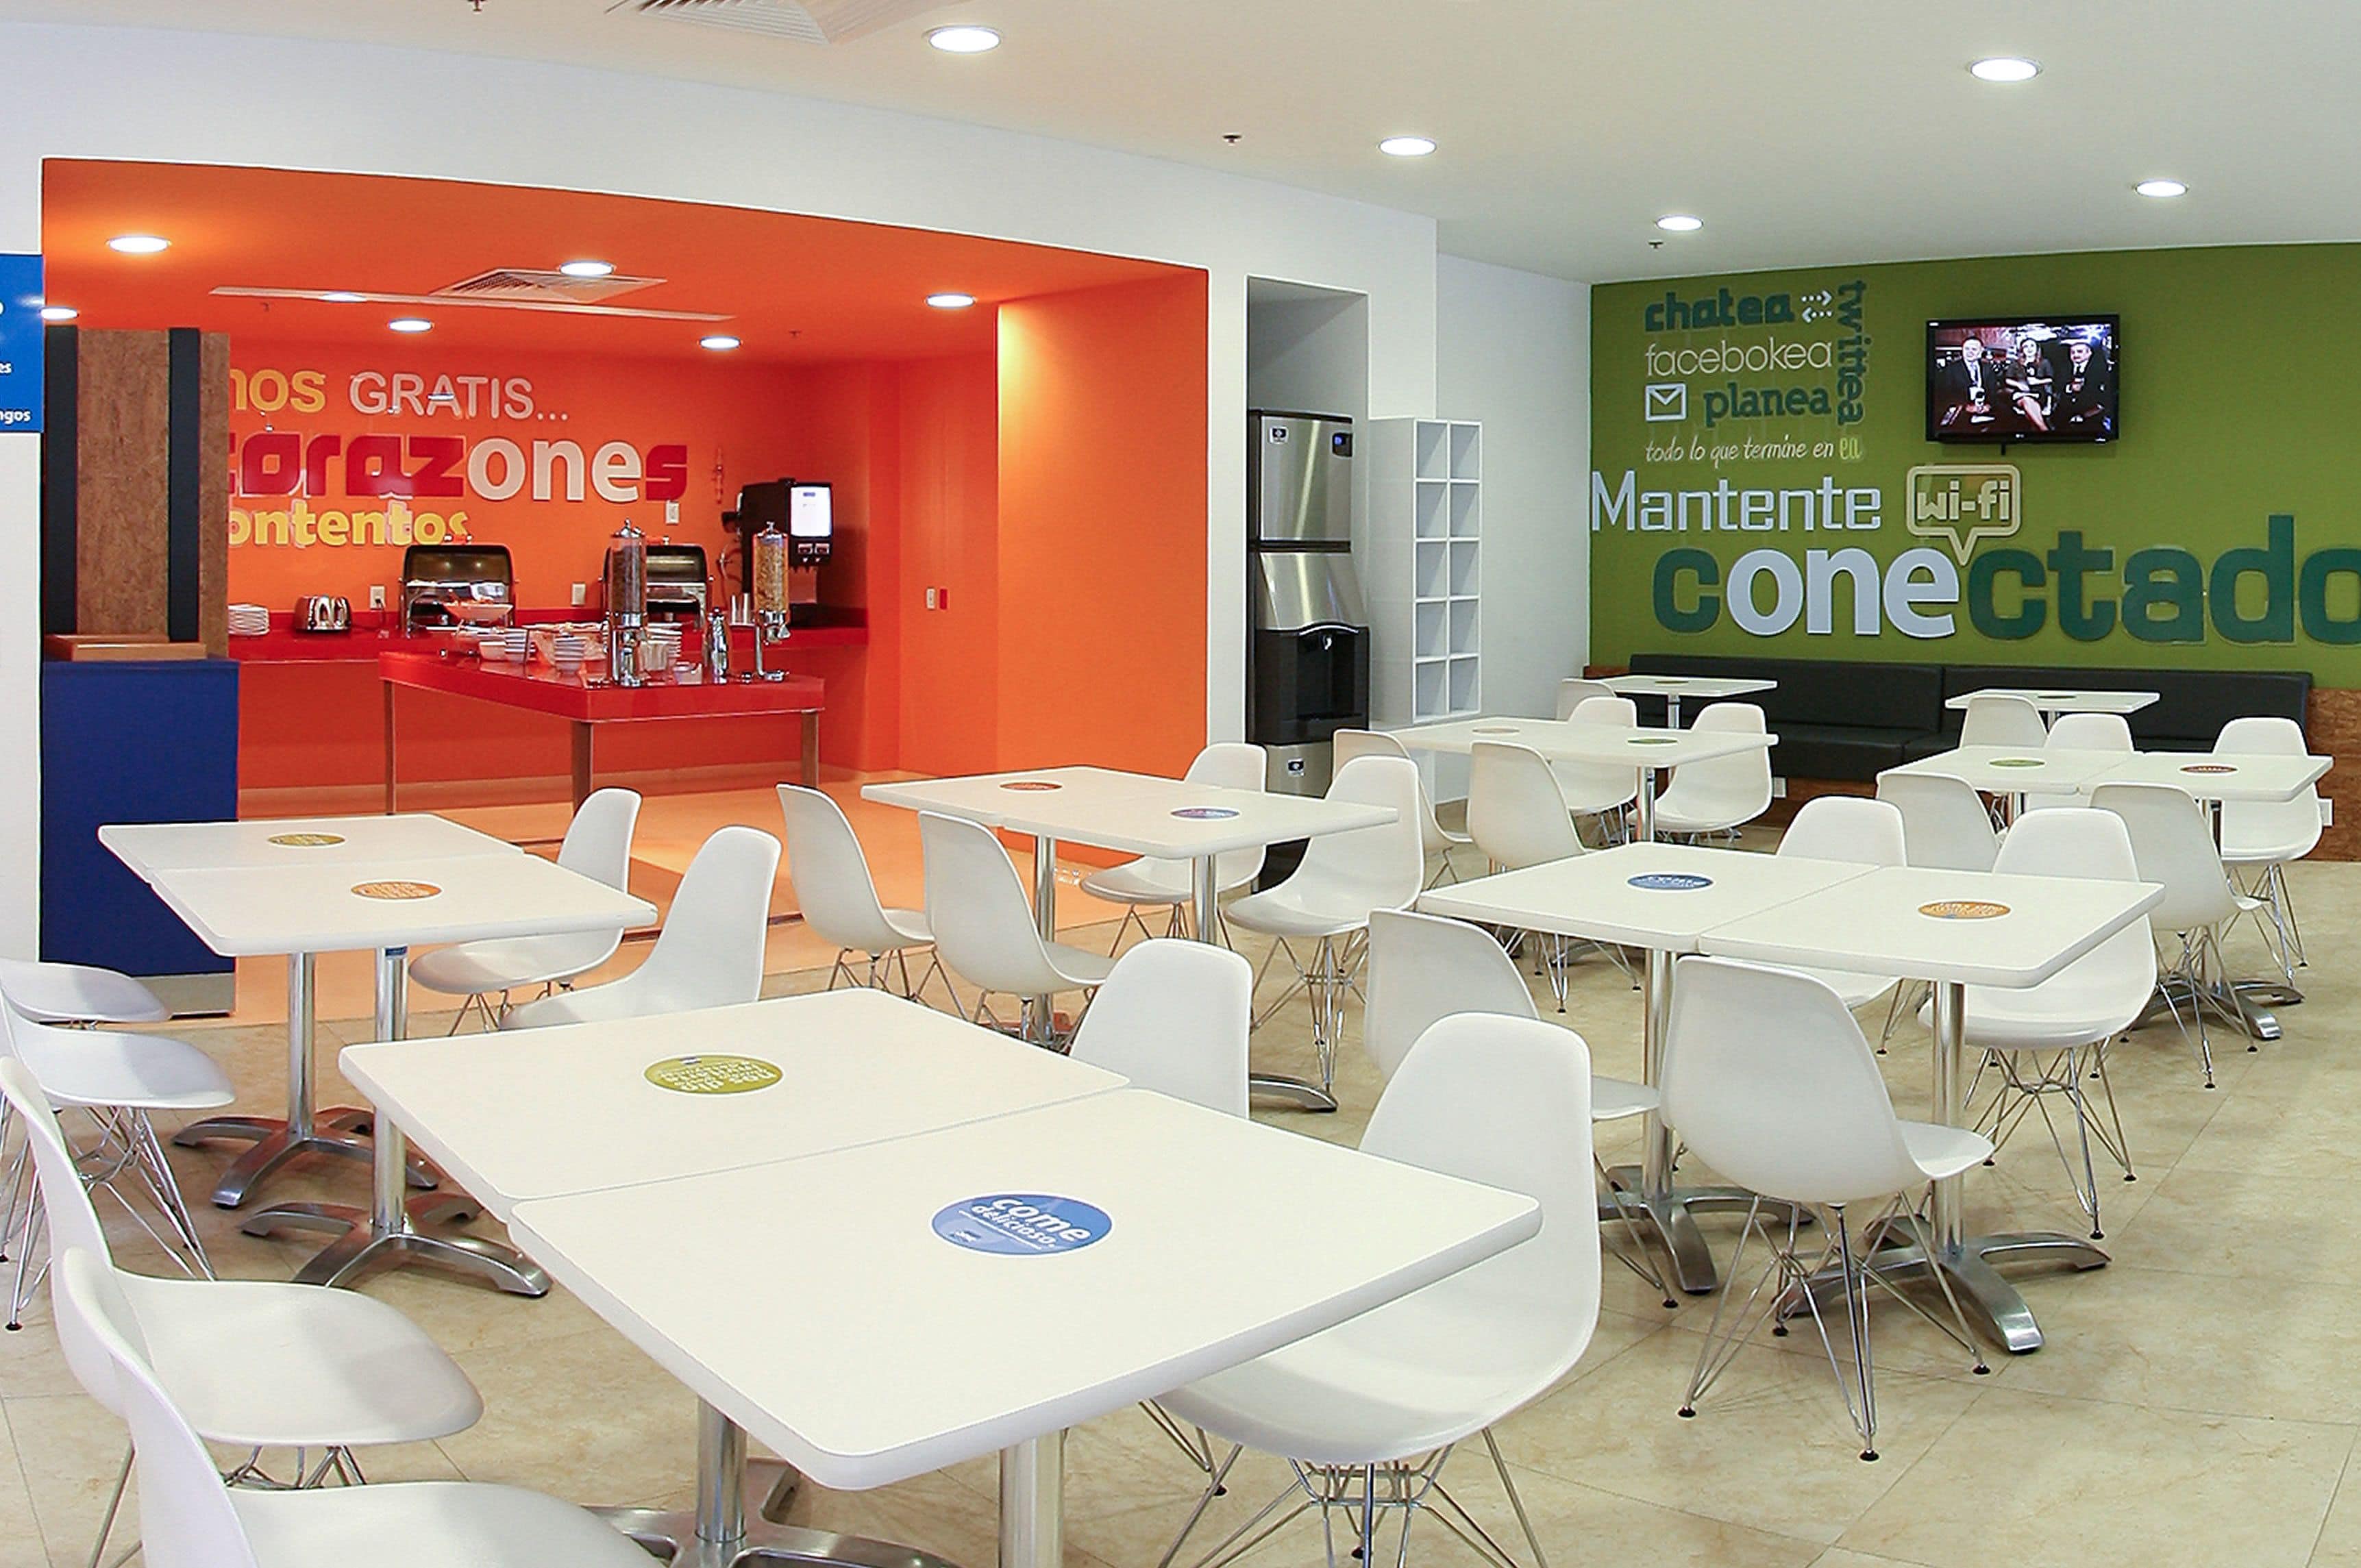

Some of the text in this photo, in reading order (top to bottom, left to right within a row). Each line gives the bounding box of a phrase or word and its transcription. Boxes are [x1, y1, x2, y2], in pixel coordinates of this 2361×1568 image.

[1646, 288, 1795, 332] chatea
[1645, 337, 1833, 377] facebokea
[1837, 279, 1872, 425] twittea
[350, 372, 569, 421] GRATIS...
[1703, 382, 1831, 427] planea
[230, 432, 687, 501] orazones
[1646, 434, 1862, 469] todo lo que termine en ea
[1591, 470, 1881, 532] Mantente
[1916, 477, 2013, 522] wi-fi
[1653, 515, 2361, 644] conectado
[993, 1198, 1092, 1242] come
